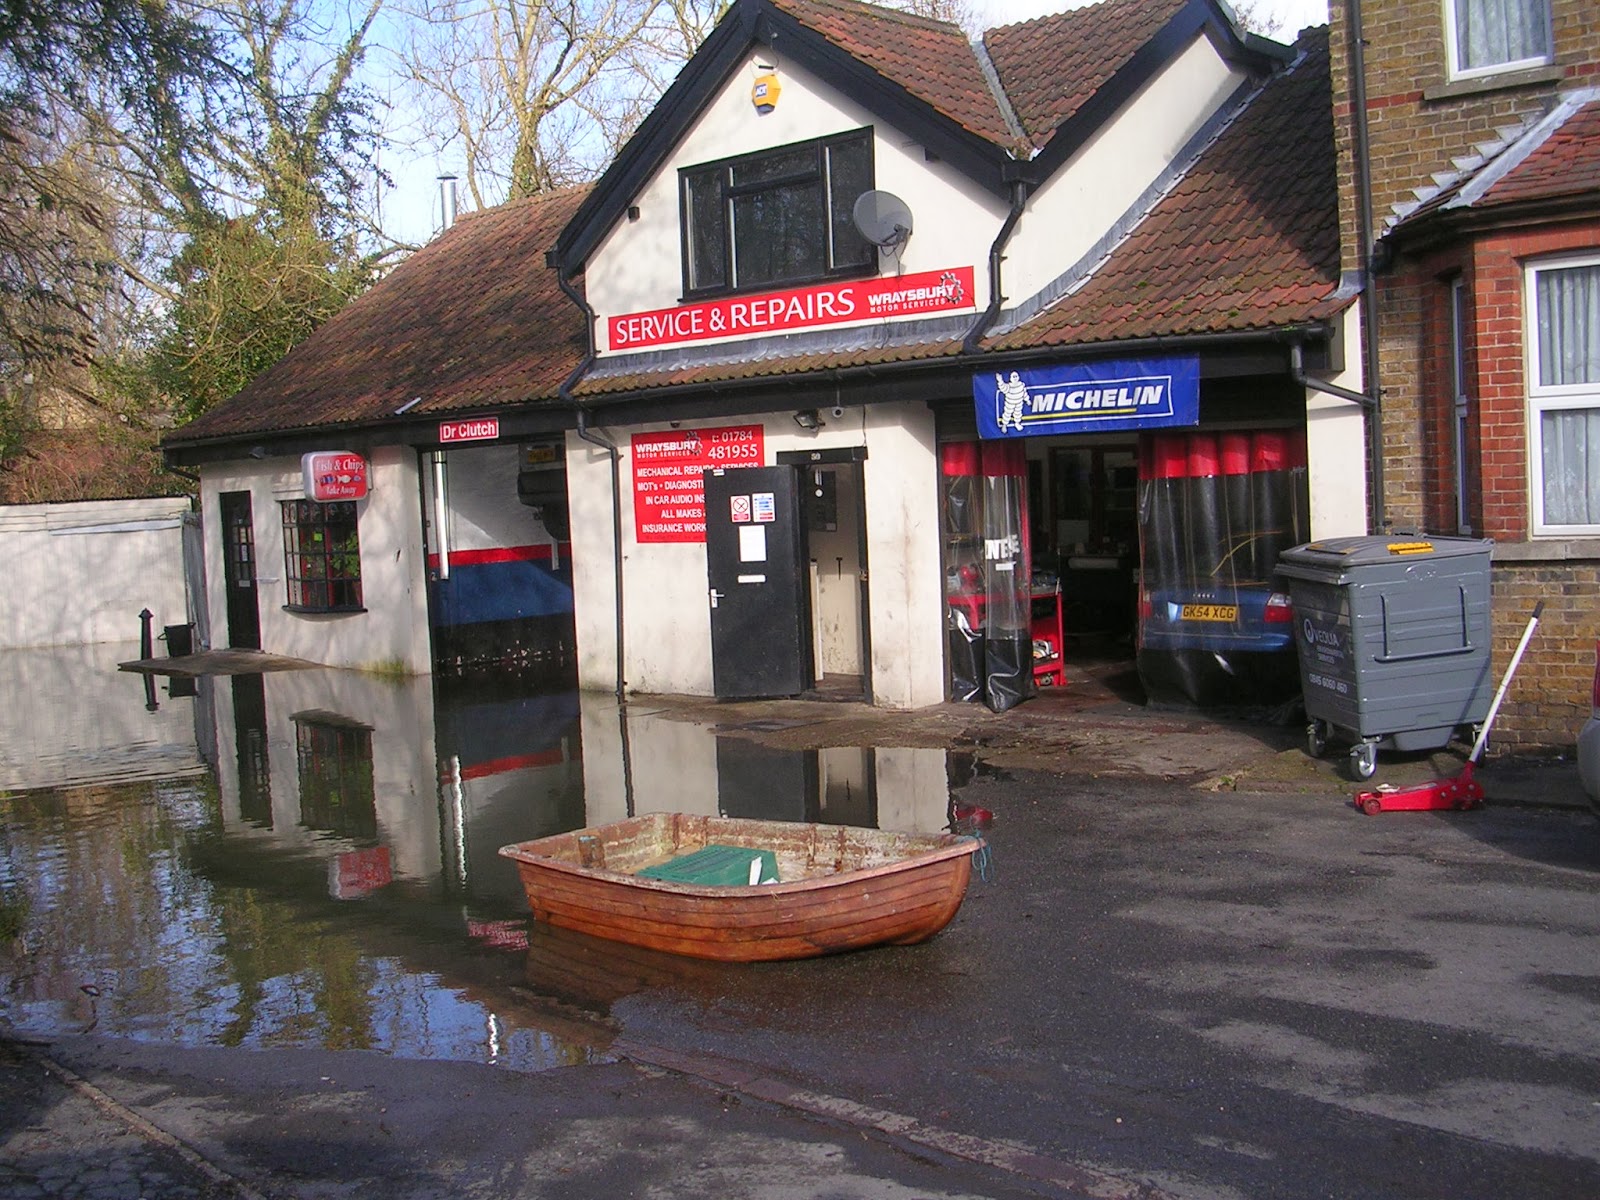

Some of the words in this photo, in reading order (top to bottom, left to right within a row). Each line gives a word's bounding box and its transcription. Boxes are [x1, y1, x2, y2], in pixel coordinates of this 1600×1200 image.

[868, 284, 955, 305] WRAYSBURY
[870, 303, 899, 313] MOTOR
[902, 298, 946, 309] SERVICES
[616, 309, 704, 344] SERVICE
[709, 307, 726, 331] &
[730, 288, 855, 328] REPAIRS
[1031, 385, 1163, 412] MICHELIN
[443, 425, 456, 439] Dr
[458, 421, 495, 437] Clutch
[721, 430, 753, 443] 01784
[635, 440, 697, 453] WRAYSBURY
[707, 444, 758, 459] 481955
[316, 460, 332, 471] Fish
[334, 459, 341, 471] &
[343, 458, 364, 473] Chips
[637, 466, 682, 478] MECHANICAL
[326, 485, 340, 495] Take
[340, 485, 357, 497] Away
[637, 481, 658, 492] MOT's
[664, 480, 704, 490] DIAGNOSTI
[645, 496, 653, 505] IN
[654, 495, 670, 504] CAR
[670, 494, 693, 504] AUDIO
[661, 509, 675, 519] ALL
[676, 508, 702, 518] MAKES
[642, 523, 683, 533] INSURANCE
[684, 522, 706, 532] WORK
[1183, 606, 1209, 618] GK54
[1212, 606, 1234, 619] XCG
